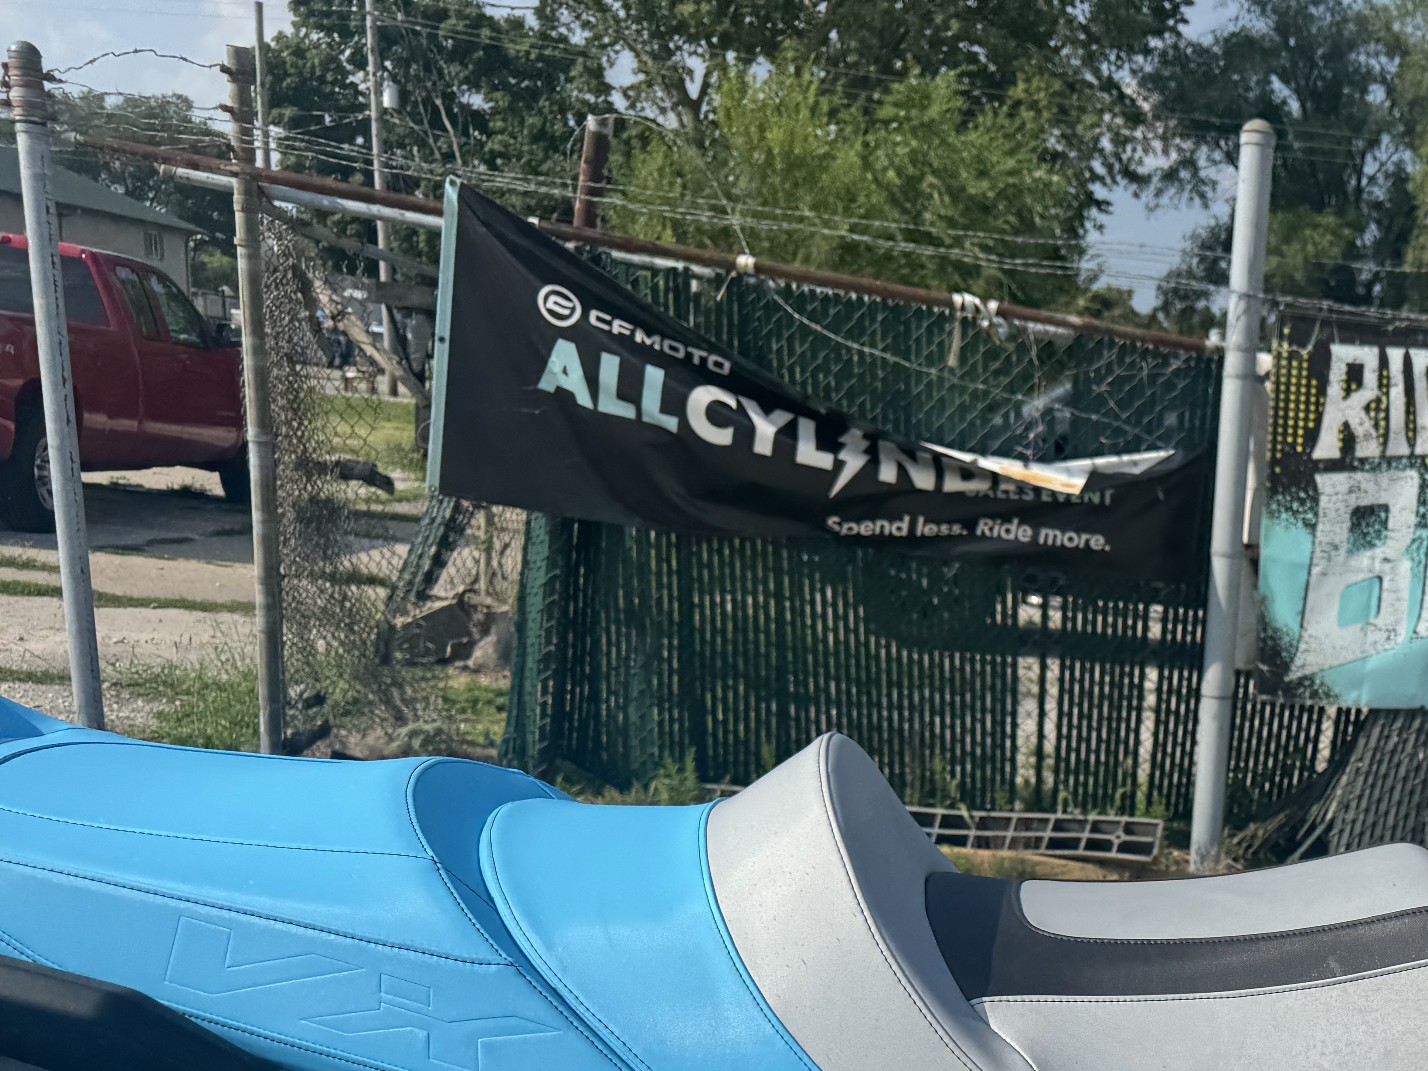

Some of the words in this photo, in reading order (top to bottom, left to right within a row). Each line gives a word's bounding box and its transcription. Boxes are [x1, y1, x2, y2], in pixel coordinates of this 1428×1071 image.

[588, 308, 732, 377] CFMOTO
[825, 513, 911, 537] Spend
[915, 514, 969, 538] less.
[975, 517, 1034, 543] Ride
[1038, 525, 1112, 552] more.
